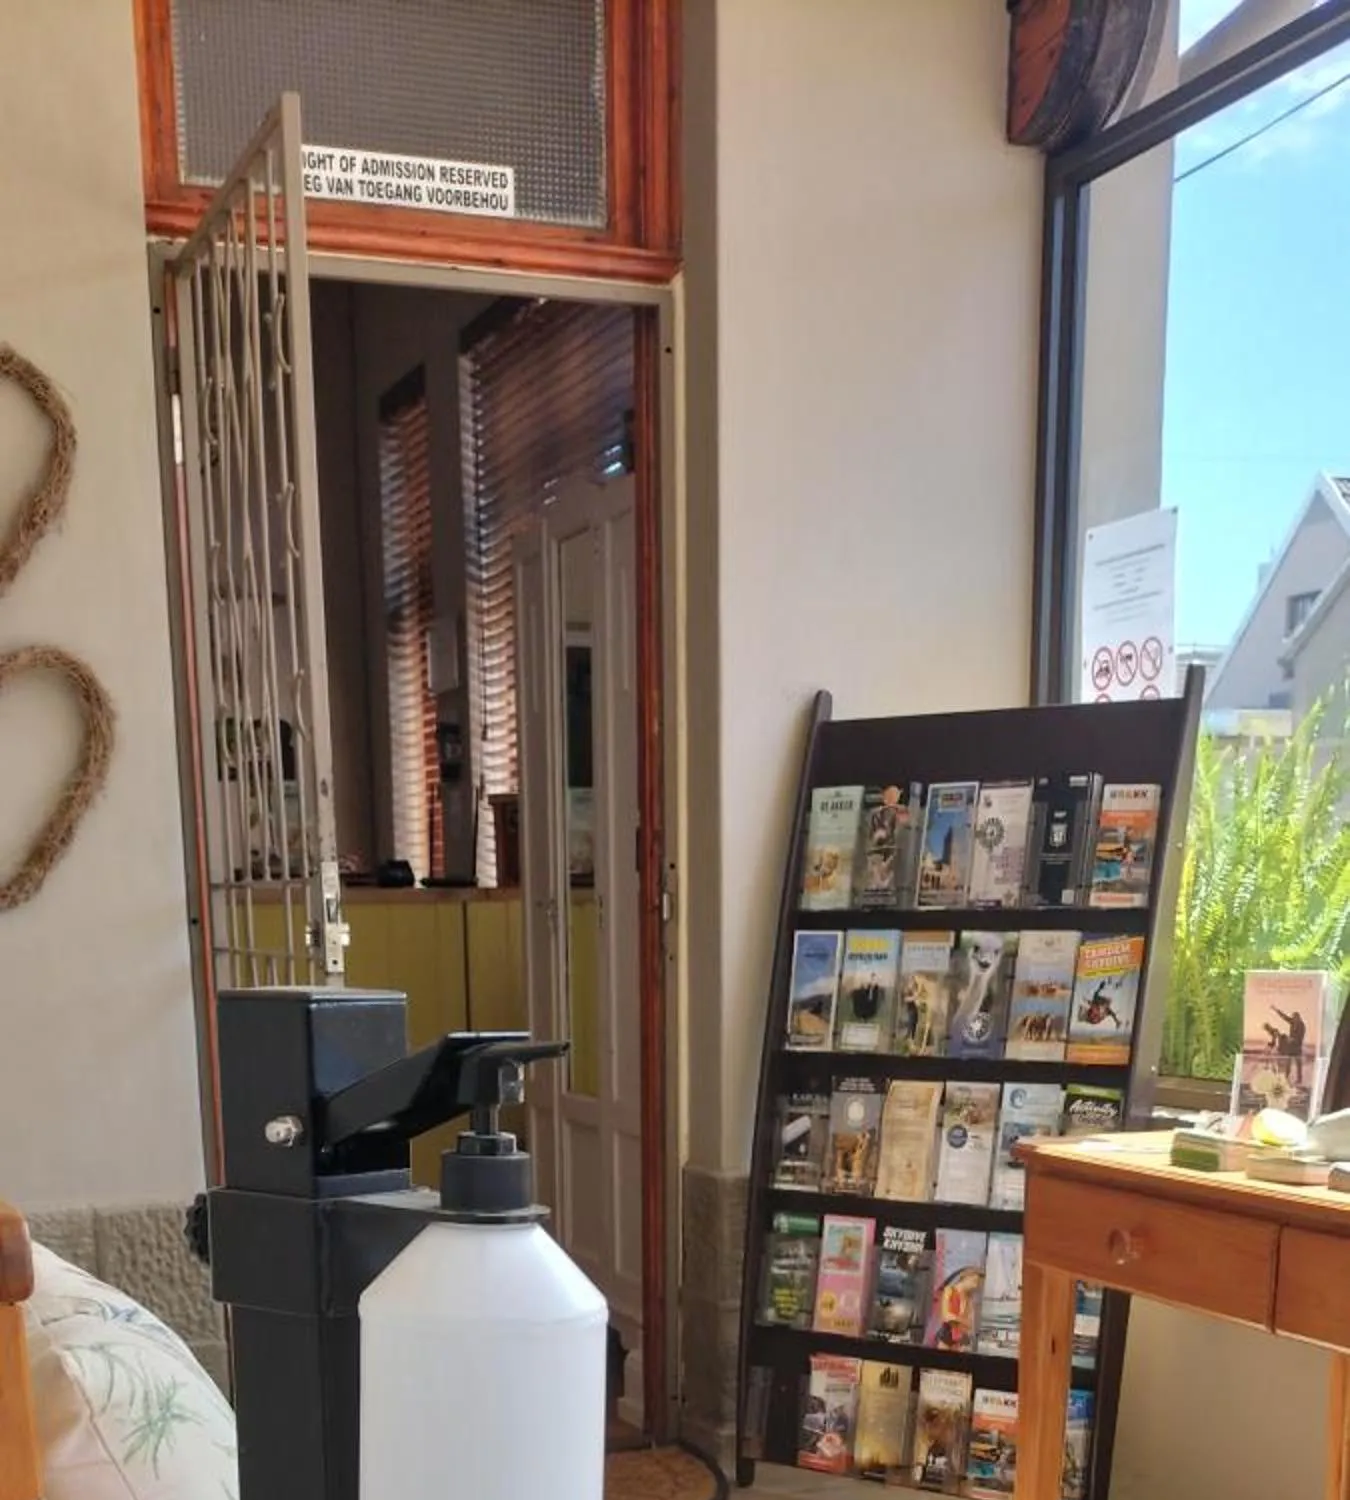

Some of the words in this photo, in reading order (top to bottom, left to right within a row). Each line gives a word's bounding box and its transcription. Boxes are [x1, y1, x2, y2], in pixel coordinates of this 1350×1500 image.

[303, 152, 334, 171] IGHT
[340, 155, 356, 173] OF
[362, 158, 435, 182] ADMISSION
[440, 166, 508, 189] RESERVED
[304, 174, 322, 193] EG
[326, 176, 354, 195] VAN
[359, 180, 422, 203] TOEGANG
[426, 186, 508, 211] VOORBEHOU
